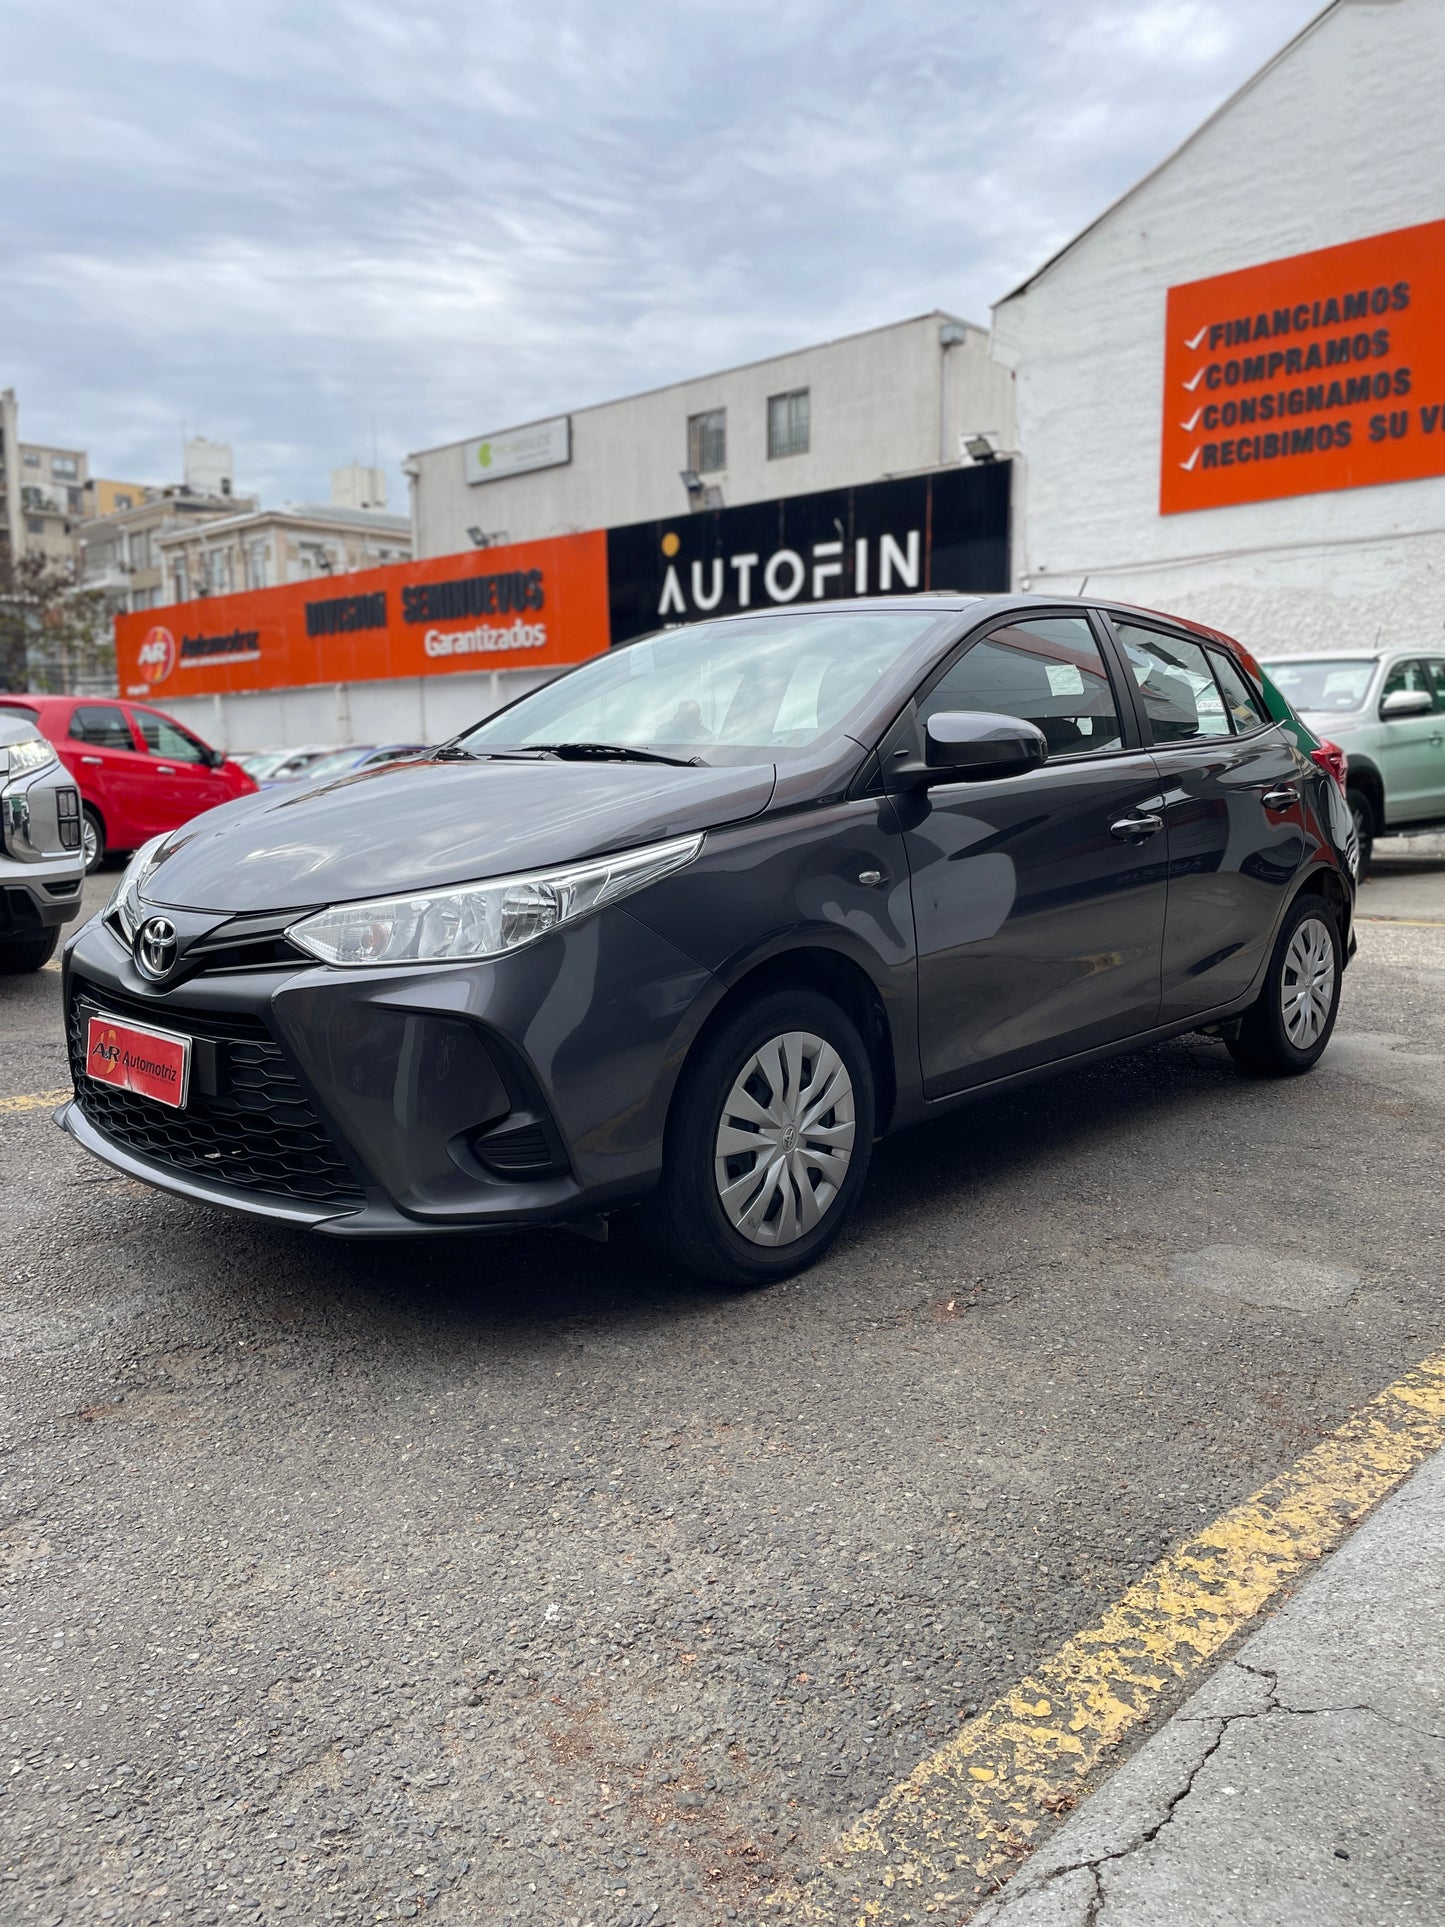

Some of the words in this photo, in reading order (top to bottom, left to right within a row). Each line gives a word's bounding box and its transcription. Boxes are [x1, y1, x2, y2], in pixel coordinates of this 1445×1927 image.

[1208, 281, 1410, 350] FINANCIAMOS
[1205, 328, 1390, 390] COMPRAMOS
[1202, 367, 1411, 430] CONSIGNAMOS
[1201, 420, 1352, 470] RECIBIMOS
[1368, 410, 1409, 443] SU
[1420, 403, 1445, 434] V
[401, 567, 545, 625] SEMINUEVOS
[657, 530, 921, 616] AUTOFIN
[424, 618, 547, 657] Garantizados
[122, 1050, 178, 1082] Automotriz
